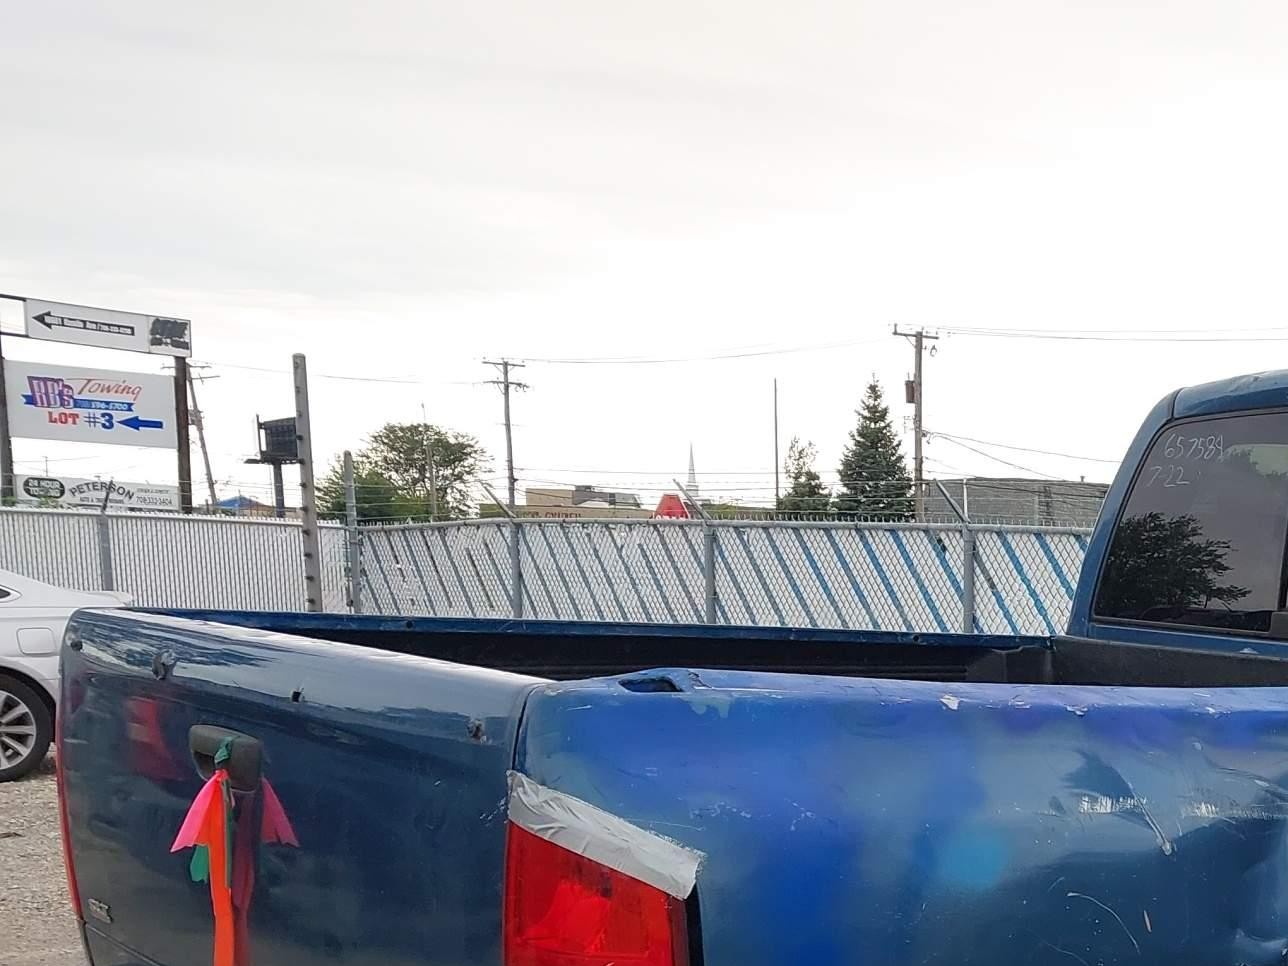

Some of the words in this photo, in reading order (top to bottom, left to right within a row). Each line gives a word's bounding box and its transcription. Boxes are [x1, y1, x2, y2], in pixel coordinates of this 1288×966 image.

[66, 377, 142, 401] Towing
[48, 411, 79, 425] LOT
[83, 411, 114, 430] #3
[69, 481, 135, 500] PETERSON
